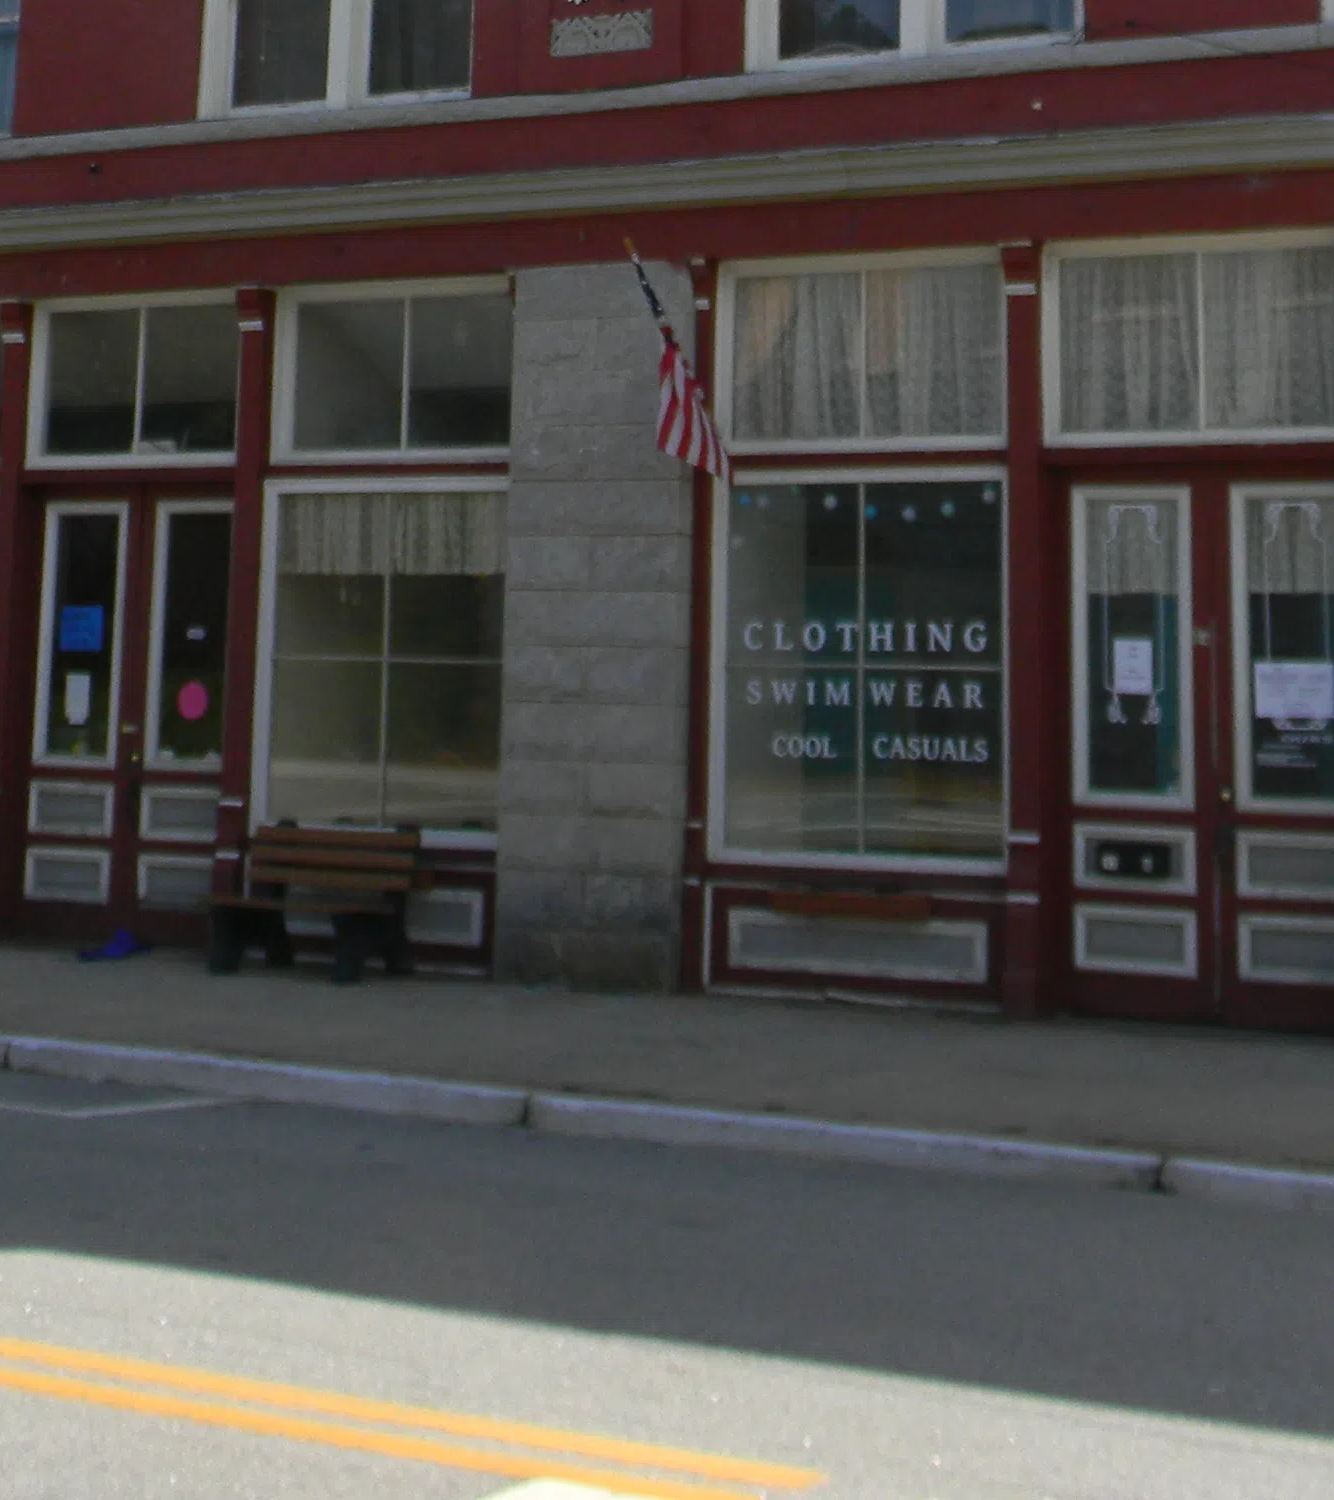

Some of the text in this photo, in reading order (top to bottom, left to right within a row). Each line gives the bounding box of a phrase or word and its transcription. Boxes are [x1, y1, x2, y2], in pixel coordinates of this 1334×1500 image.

[743, 621, 987, 653] CLOTHING
[772, 736, 989, 763] COOL CASUALS
